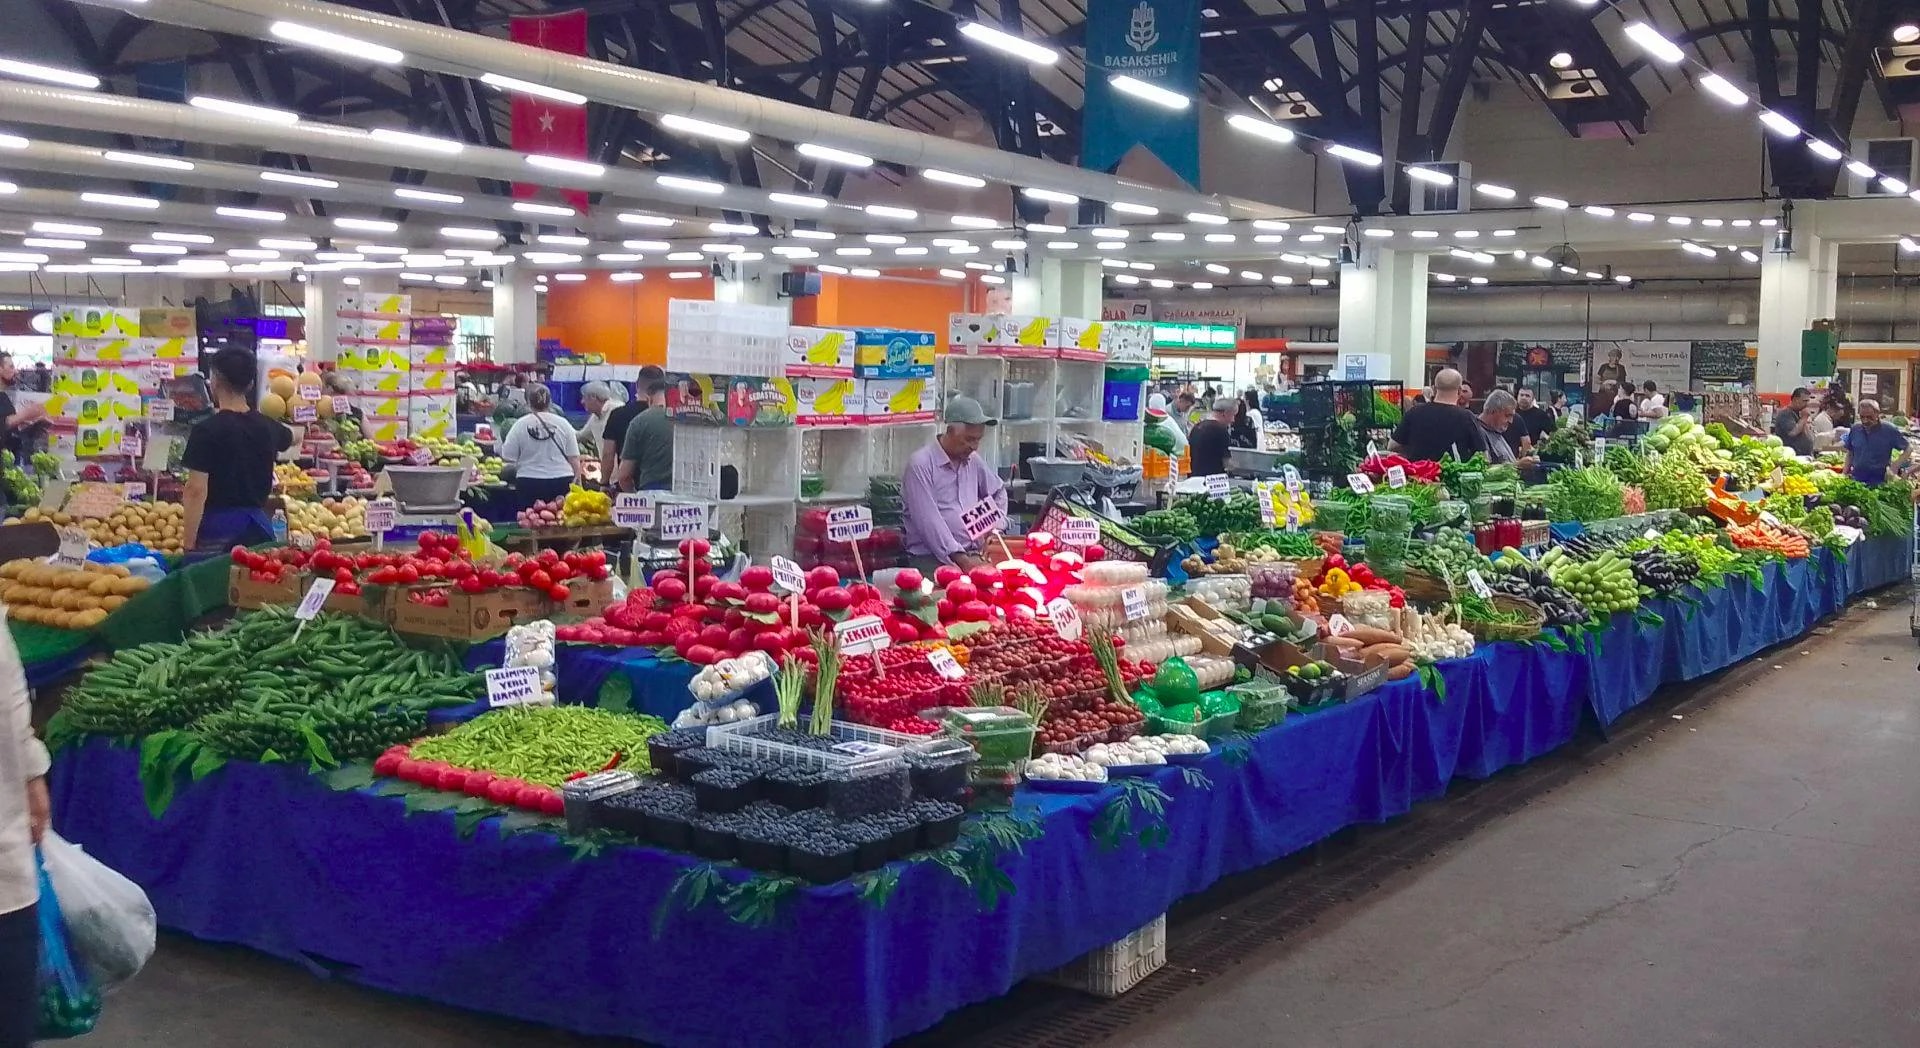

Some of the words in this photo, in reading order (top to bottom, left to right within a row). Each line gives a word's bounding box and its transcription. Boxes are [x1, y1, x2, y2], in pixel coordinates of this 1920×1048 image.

[1104, 51, 1178, 68] BAŞAKŞEHİR
[1650, 350, 1689, 360] MUTFAĞI
[761, 382, 776, 392] SAN
[968, 510, 1001, 537] TOHUM
[492, 686, 533, 702] BAMYA
